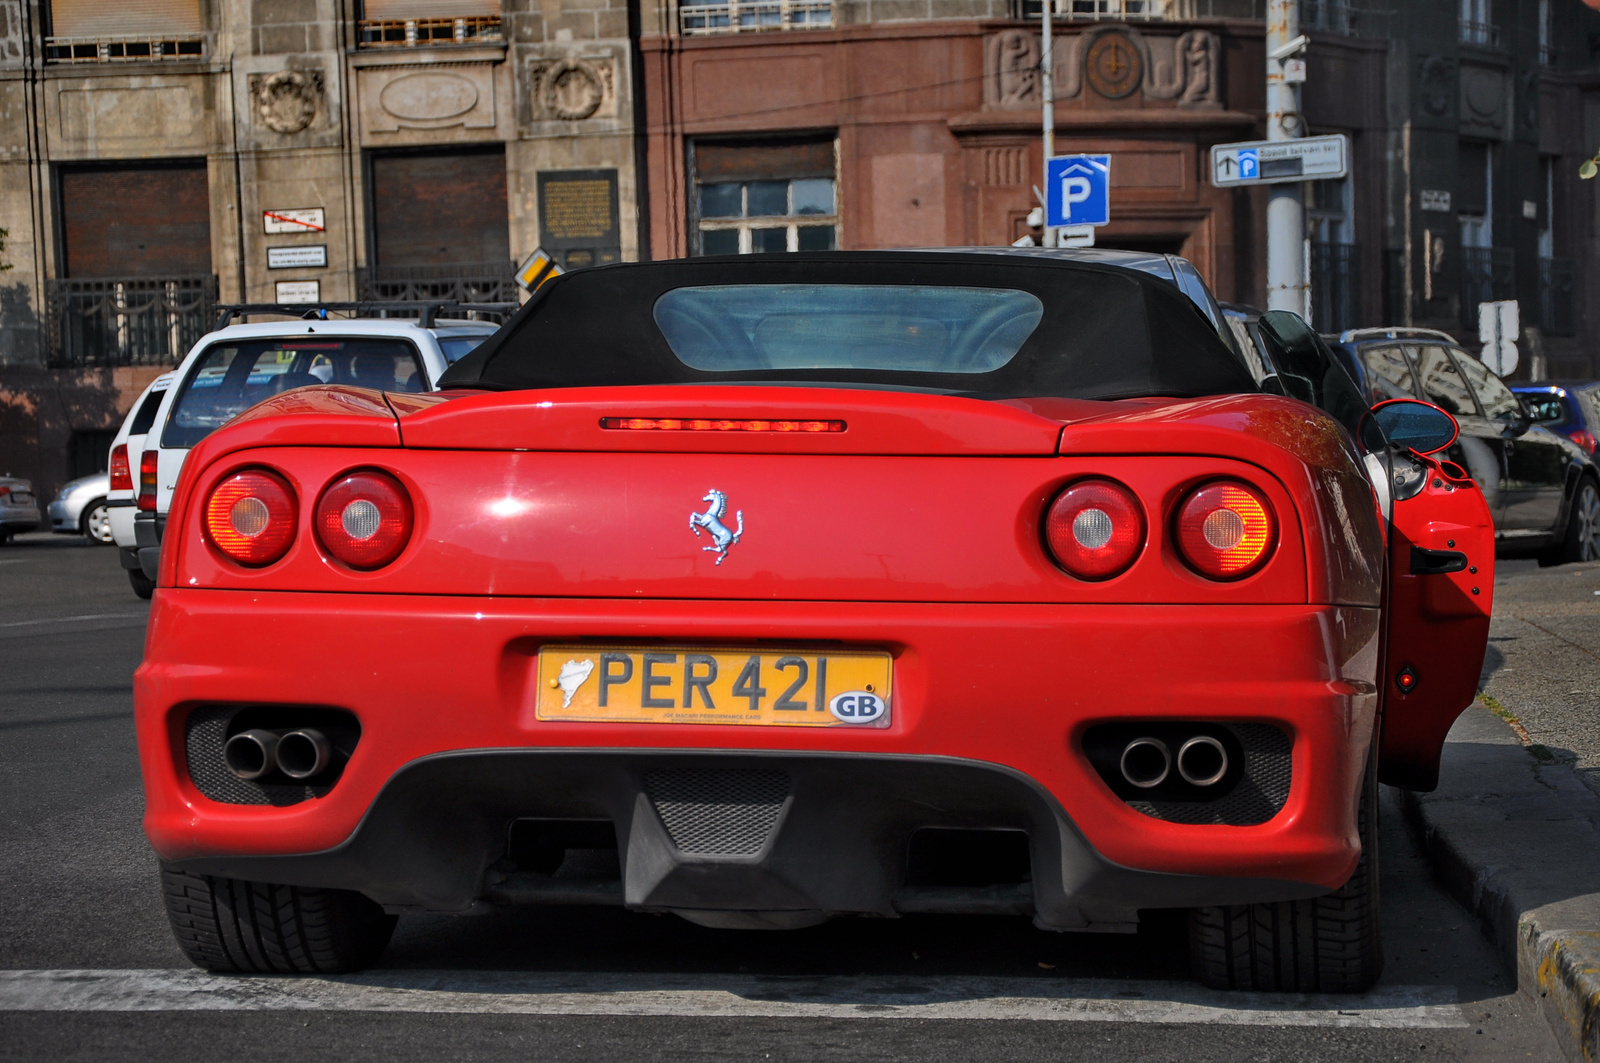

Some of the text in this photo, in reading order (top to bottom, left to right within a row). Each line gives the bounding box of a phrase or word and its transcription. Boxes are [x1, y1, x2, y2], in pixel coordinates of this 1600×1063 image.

[1242, 159, 1254, 177] P
[1061, 176, 1092, 220] P
[598, 652, 827, 712] PER 421
[835, 694, 877, 718] GB
